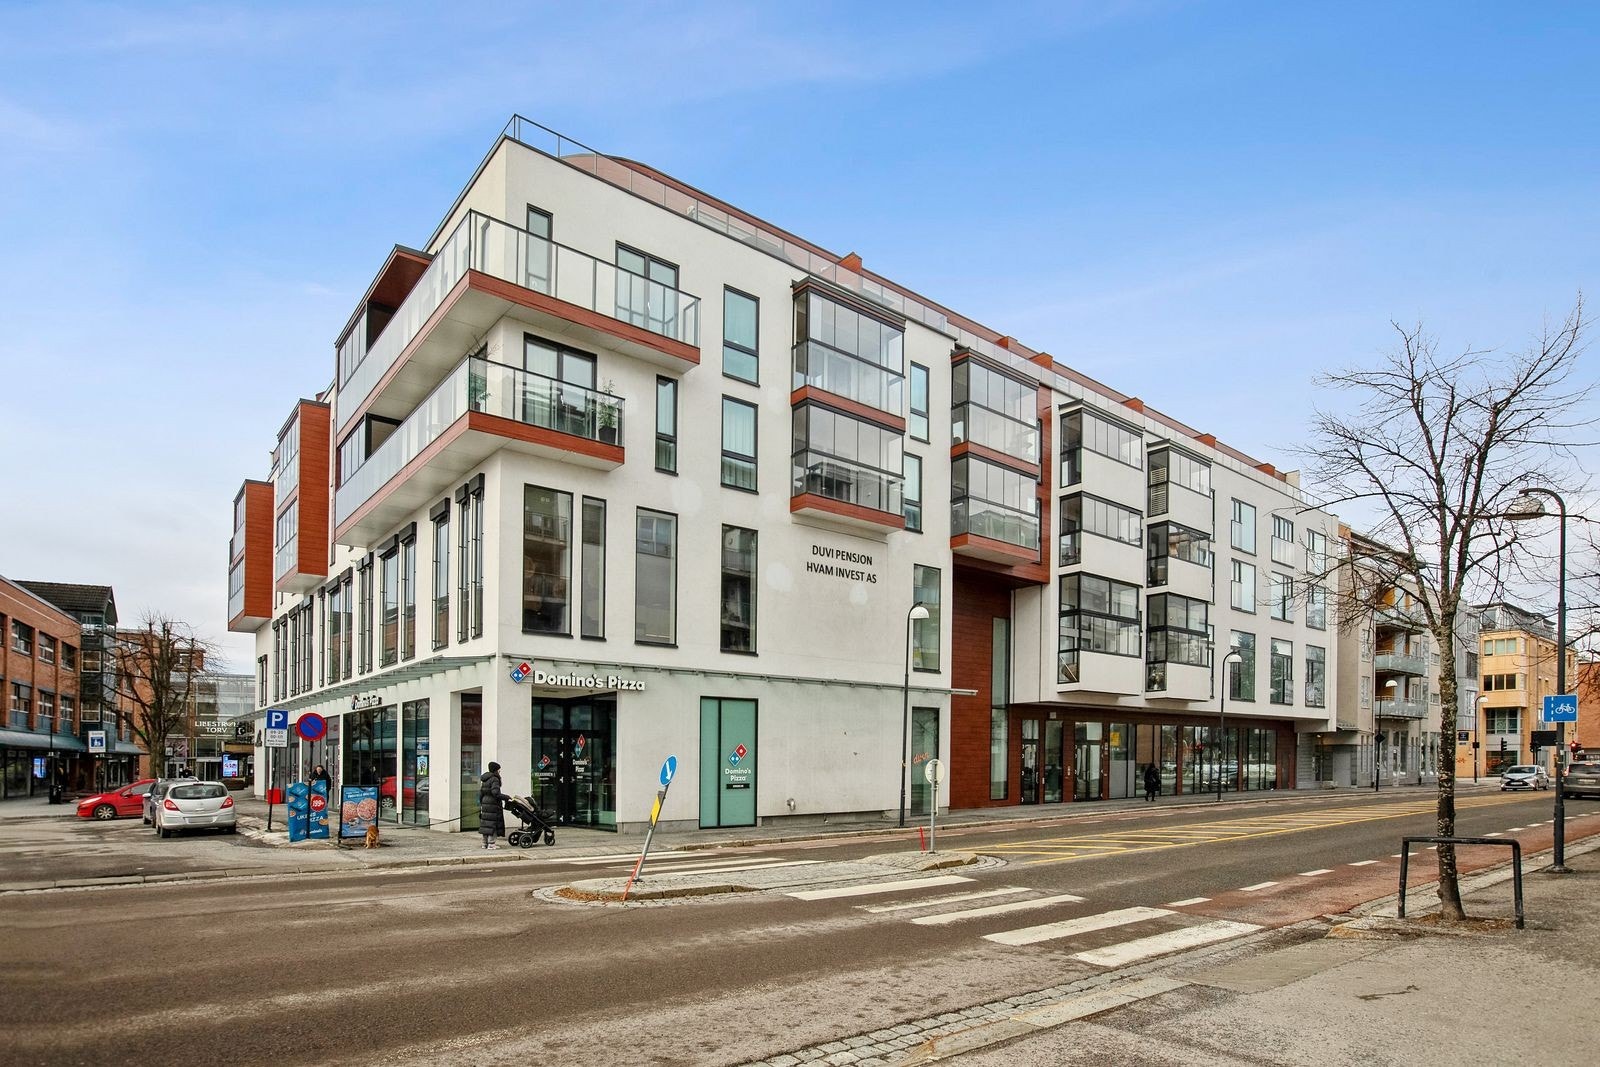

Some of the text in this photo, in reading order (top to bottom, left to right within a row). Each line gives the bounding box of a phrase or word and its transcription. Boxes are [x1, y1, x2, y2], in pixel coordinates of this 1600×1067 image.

[812, 545, 873, 566] DUVI PENSJON
[806, 562, 877, 584] HVAM INVEST AS
[533, 670, 646, 691] Domino's Pizza
[271, 712, 284, 727] P
[724, 767, 752, 775] Domino's
[730, 774, 746, 782] Pizza
